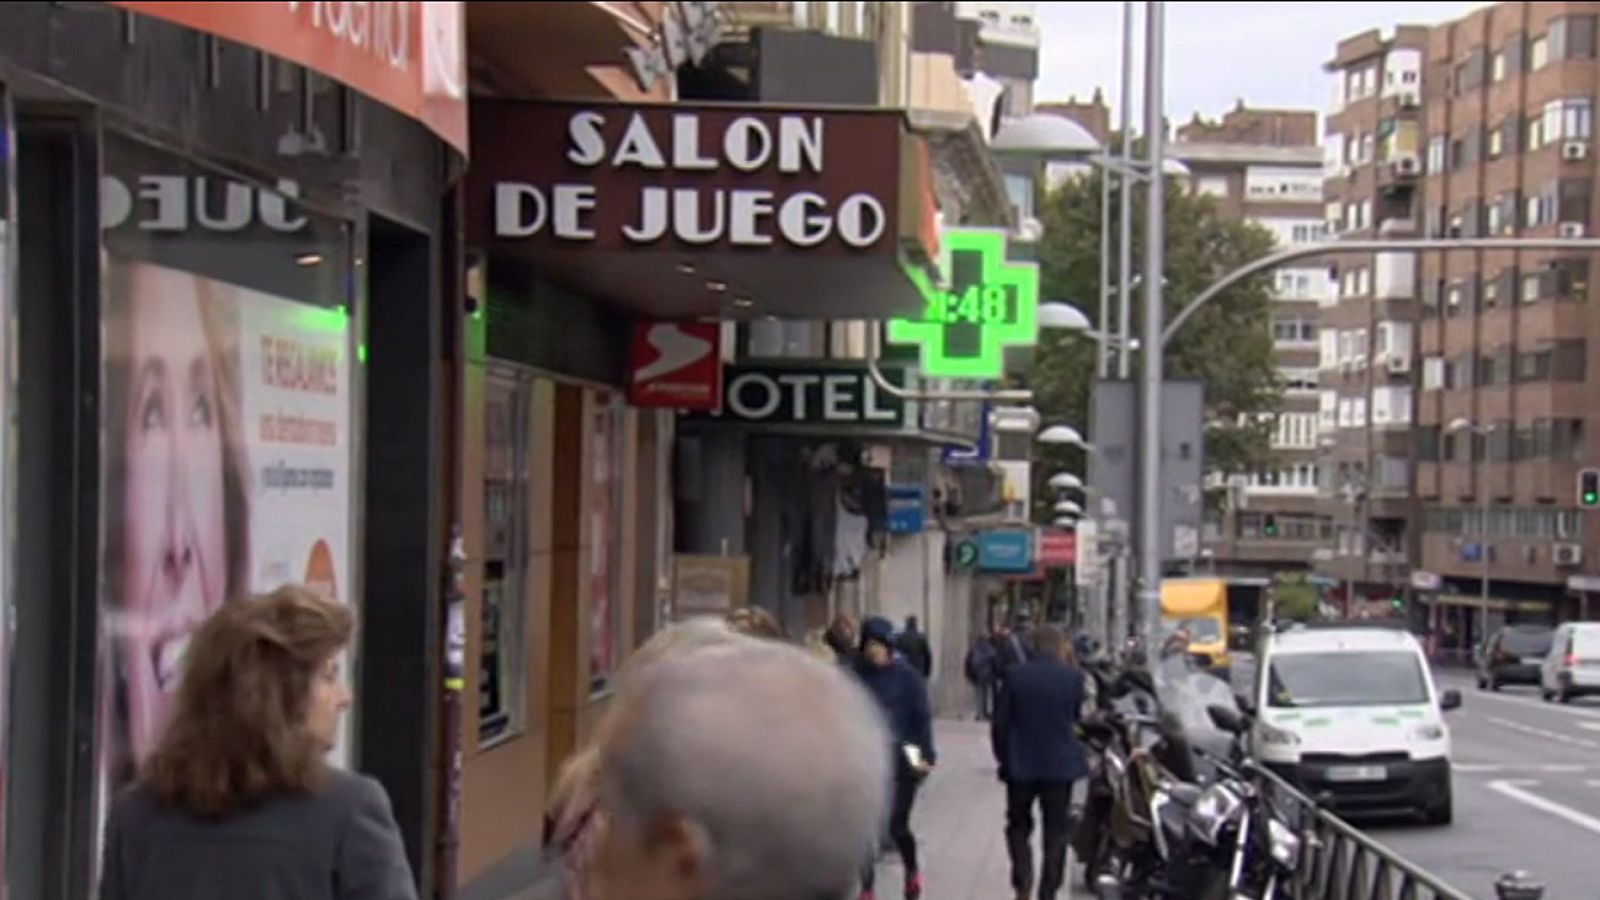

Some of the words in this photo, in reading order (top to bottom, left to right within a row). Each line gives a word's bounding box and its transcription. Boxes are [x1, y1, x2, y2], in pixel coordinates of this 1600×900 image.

[567, 111, 824, 173] SALON
[494, 182, 596, 239] DE
[622, 186, 886, 247] JUEGO
[677, 372, 897, 421] OTEL
